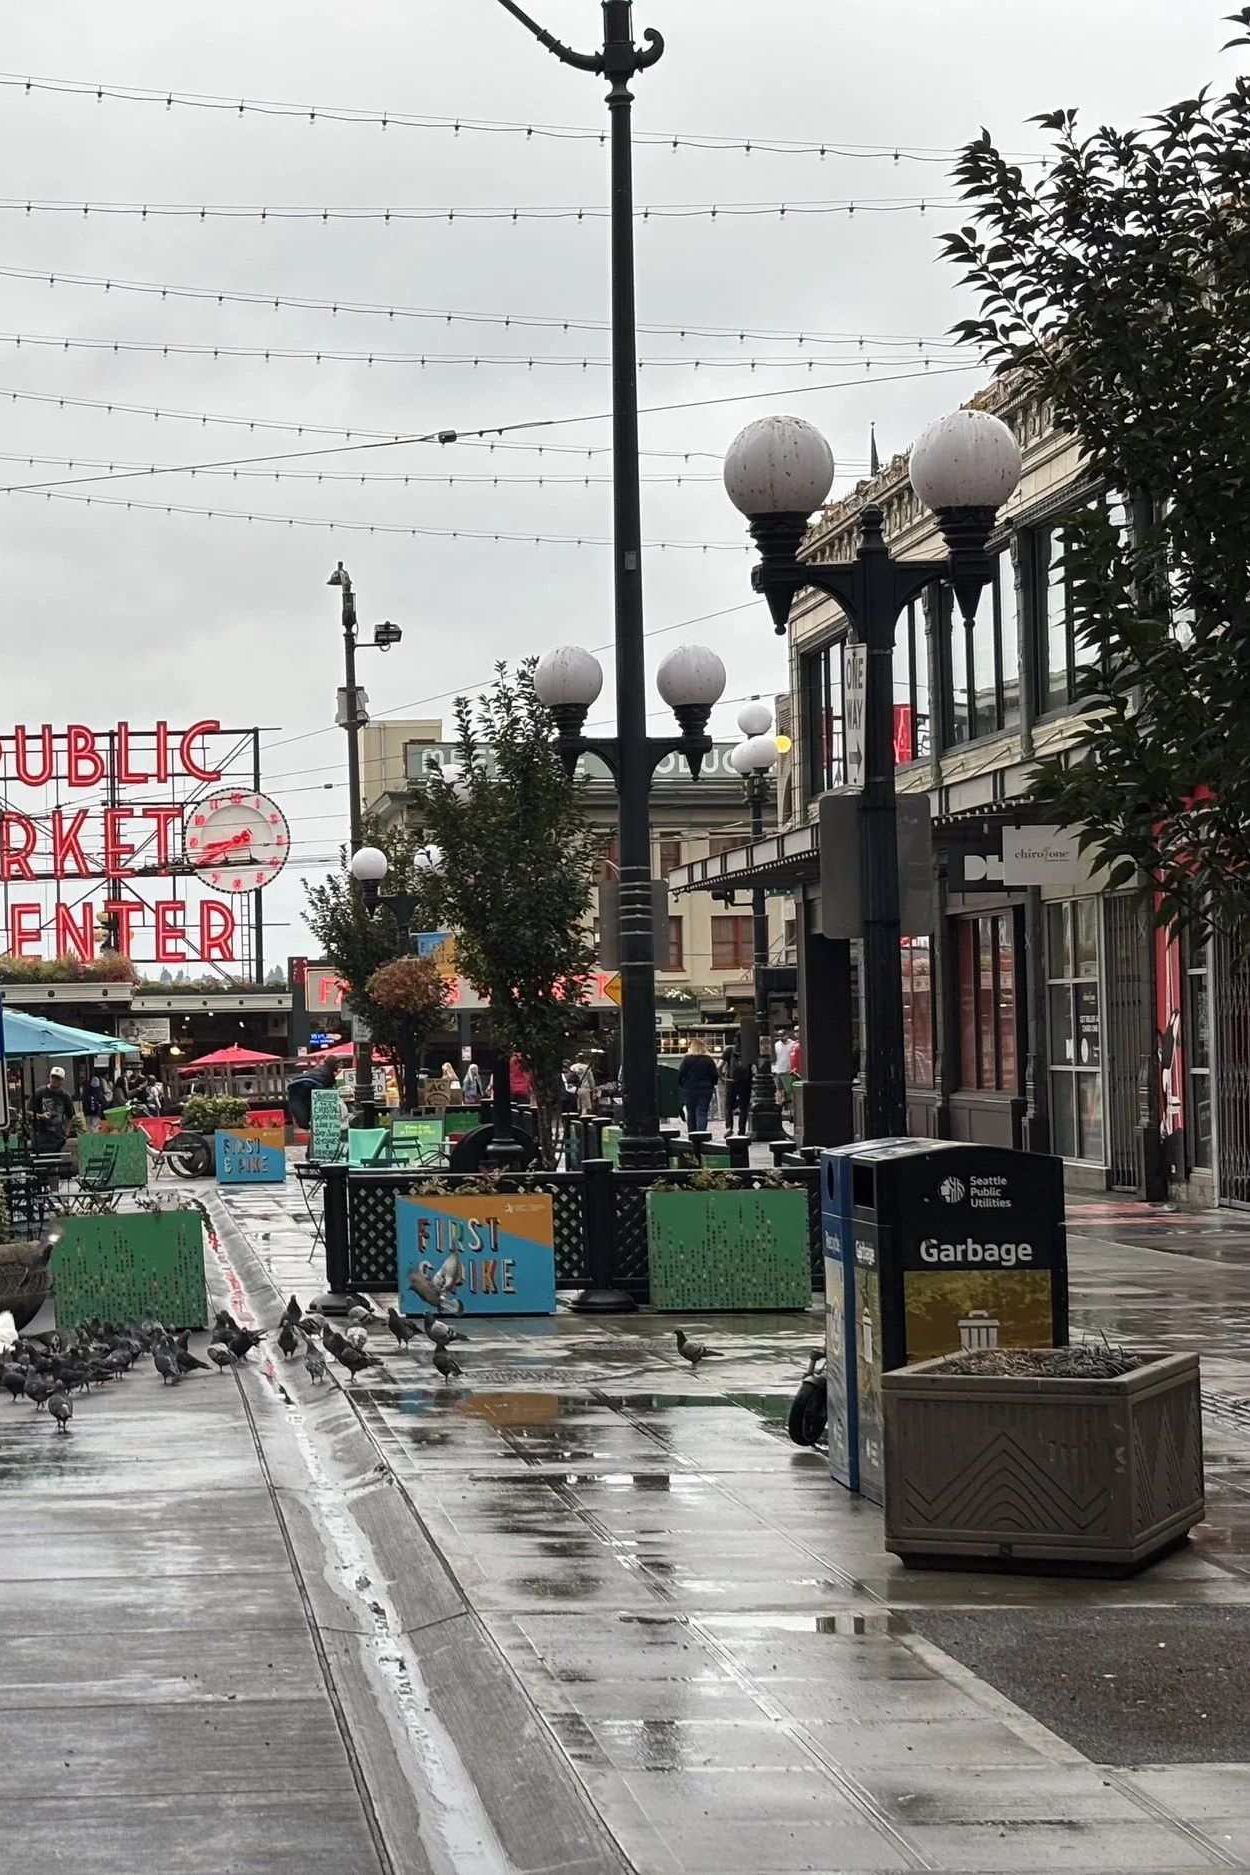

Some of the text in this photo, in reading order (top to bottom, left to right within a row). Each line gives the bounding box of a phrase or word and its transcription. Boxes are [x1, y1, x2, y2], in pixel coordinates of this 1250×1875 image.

[846, 658, 863, 690] ONE
[846, 699, 863, 730] WAY
[223, 1137, 260, 1155] FIRST
[237, 1156, 268, 1174] PIKE
[969, 1175, 1008, 1187] Seattle
[970, 1187, 1002, 1197] Public
[970, 1198, 1012, 1208] Utilities
[417, 1216, 500, 1253] FIRST
[919, 1238, 1033, 1266] Garbage
